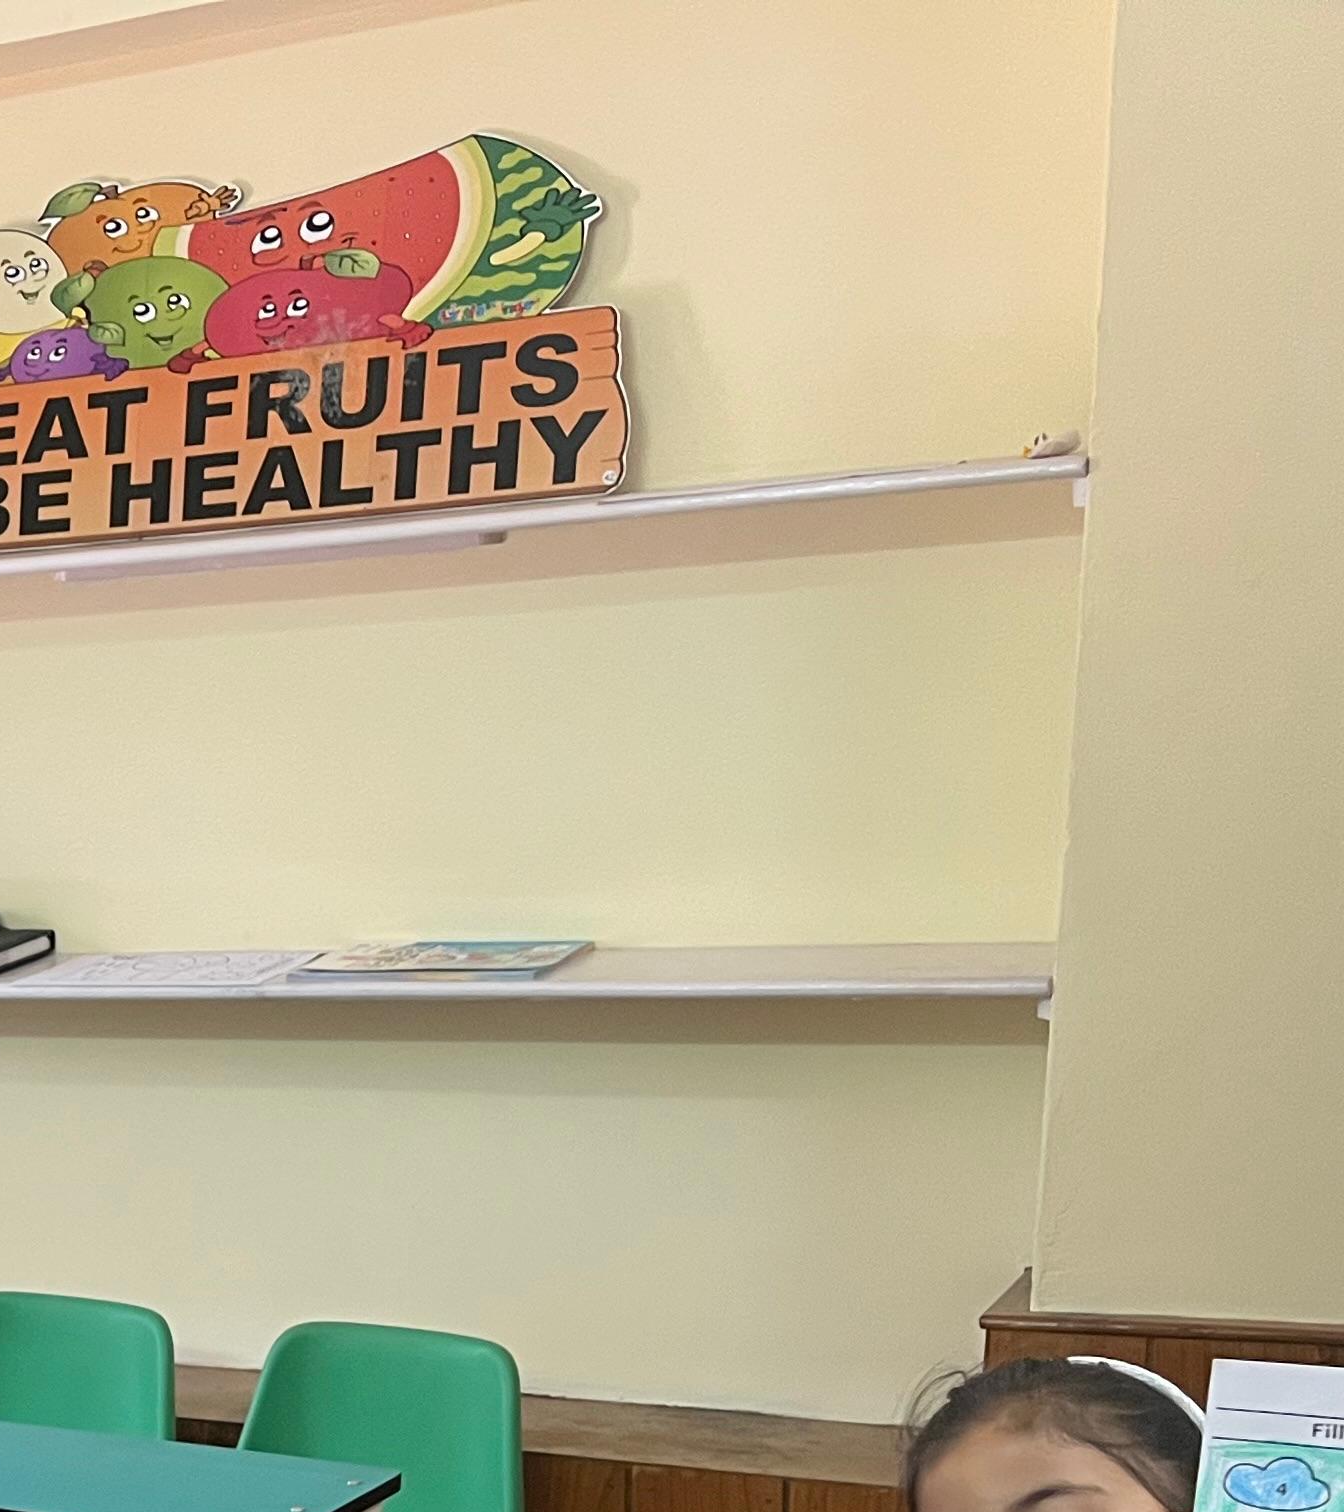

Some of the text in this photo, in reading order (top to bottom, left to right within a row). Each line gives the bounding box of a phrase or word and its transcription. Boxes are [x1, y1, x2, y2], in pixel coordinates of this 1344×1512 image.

[185, 332, 580, 447] FRUITS
[109, 408, 609, 529] HEALTHY
[1312, 1422, 1344, 1440] Fill
[1276, 1483, 1287, 1496] 4
